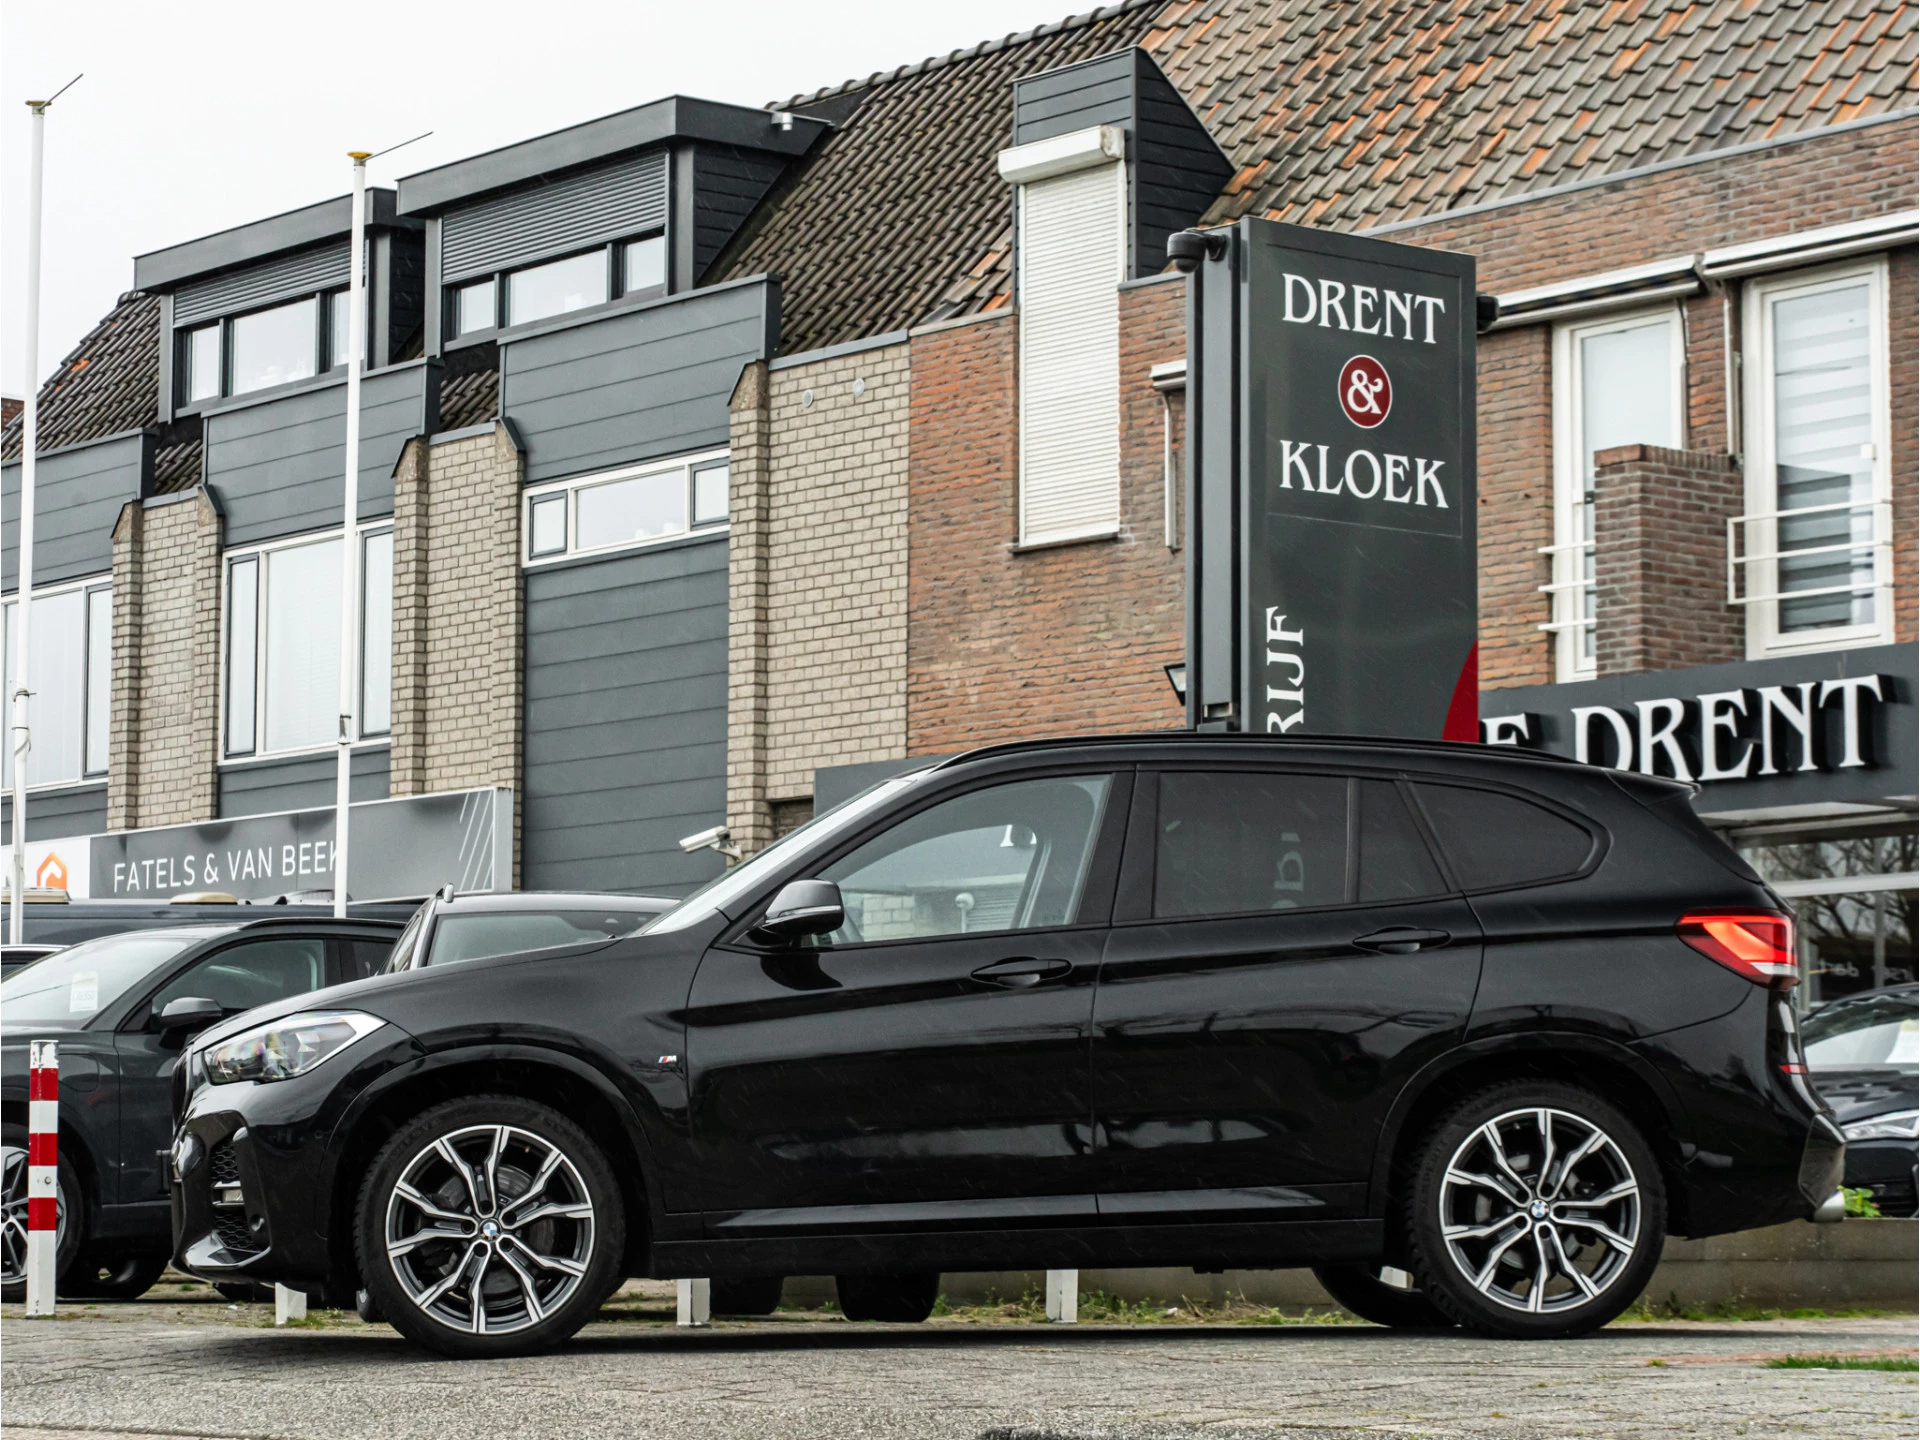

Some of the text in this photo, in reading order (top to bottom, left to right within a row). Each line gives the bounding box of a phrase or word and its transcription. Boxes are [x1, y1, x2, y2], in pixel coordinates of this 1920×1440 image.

[1282, 273, 1446, 344] DRENT
[1347, 369, 1384, 415] &
[1279, 439, 1449, 509] KLOEK
[1570, 674, 1882, 783] DRENT
[113, 854, 196, 893] FATELS
[203, 852, 220, 885] &
[227, 846, 273, 882] VAN
